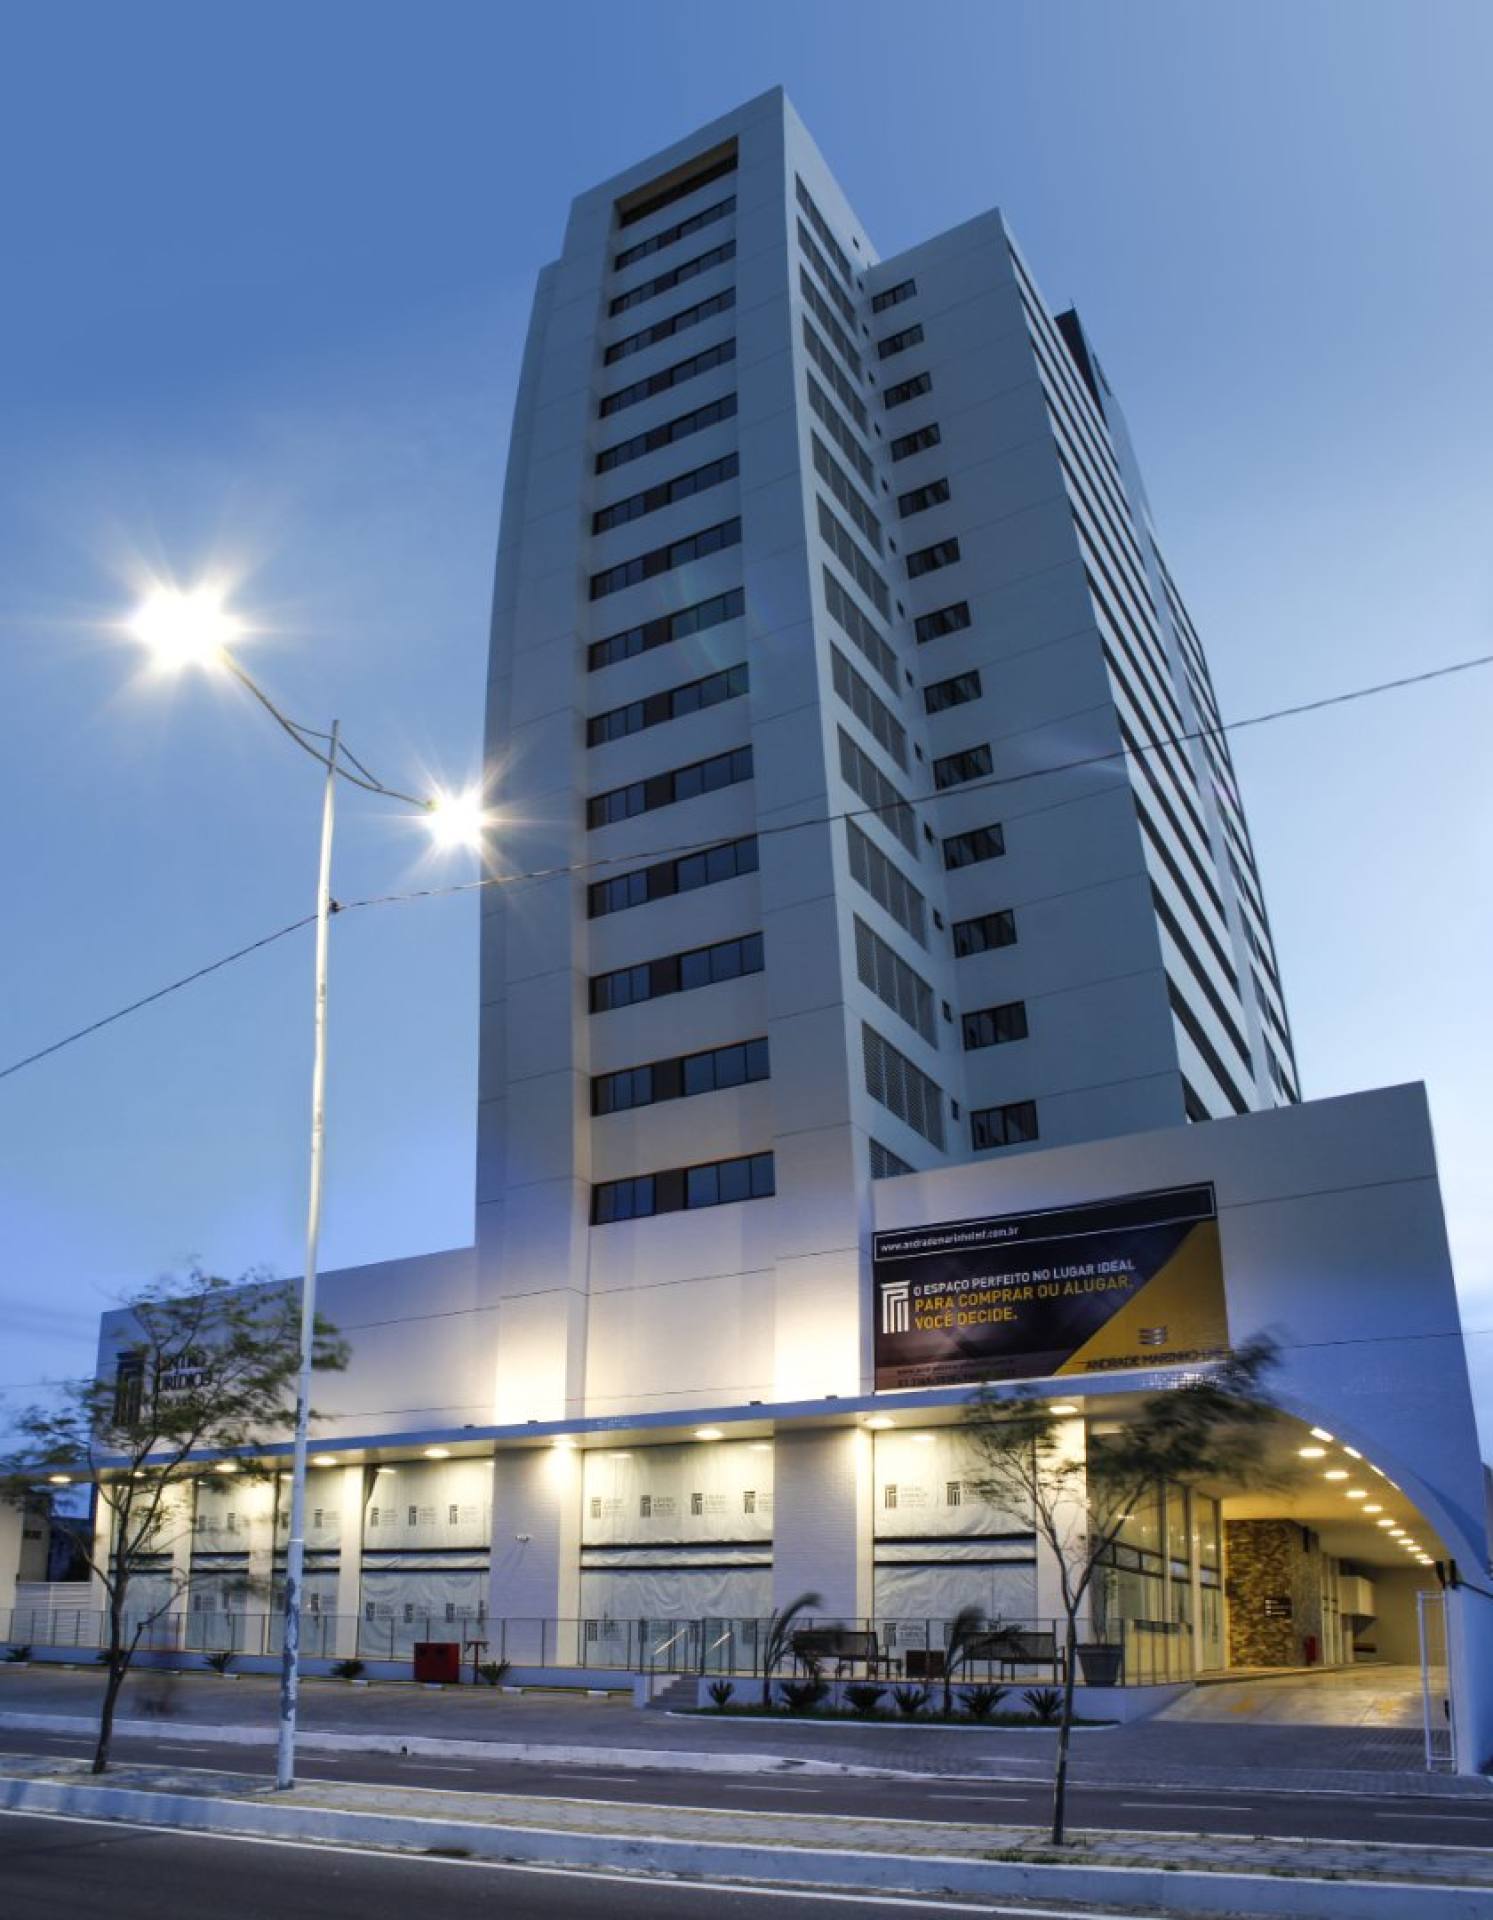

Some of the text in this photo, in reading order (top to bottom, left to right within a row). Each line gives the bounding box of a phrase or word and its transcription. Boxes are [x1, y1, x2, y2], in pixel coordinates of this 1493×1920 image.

[913, 1259, 1136, 1297] O ESPAÇO PERFEITO NO LUGAR IDEAL
[914, 1296, 955, 1313] PARA
[958, 1287, 1034, 1307] COMPRAR
[1037, 1282, 1059, 1299] OU
[914, 1306, 1018, 1330] VOCÊ DECIDE.
